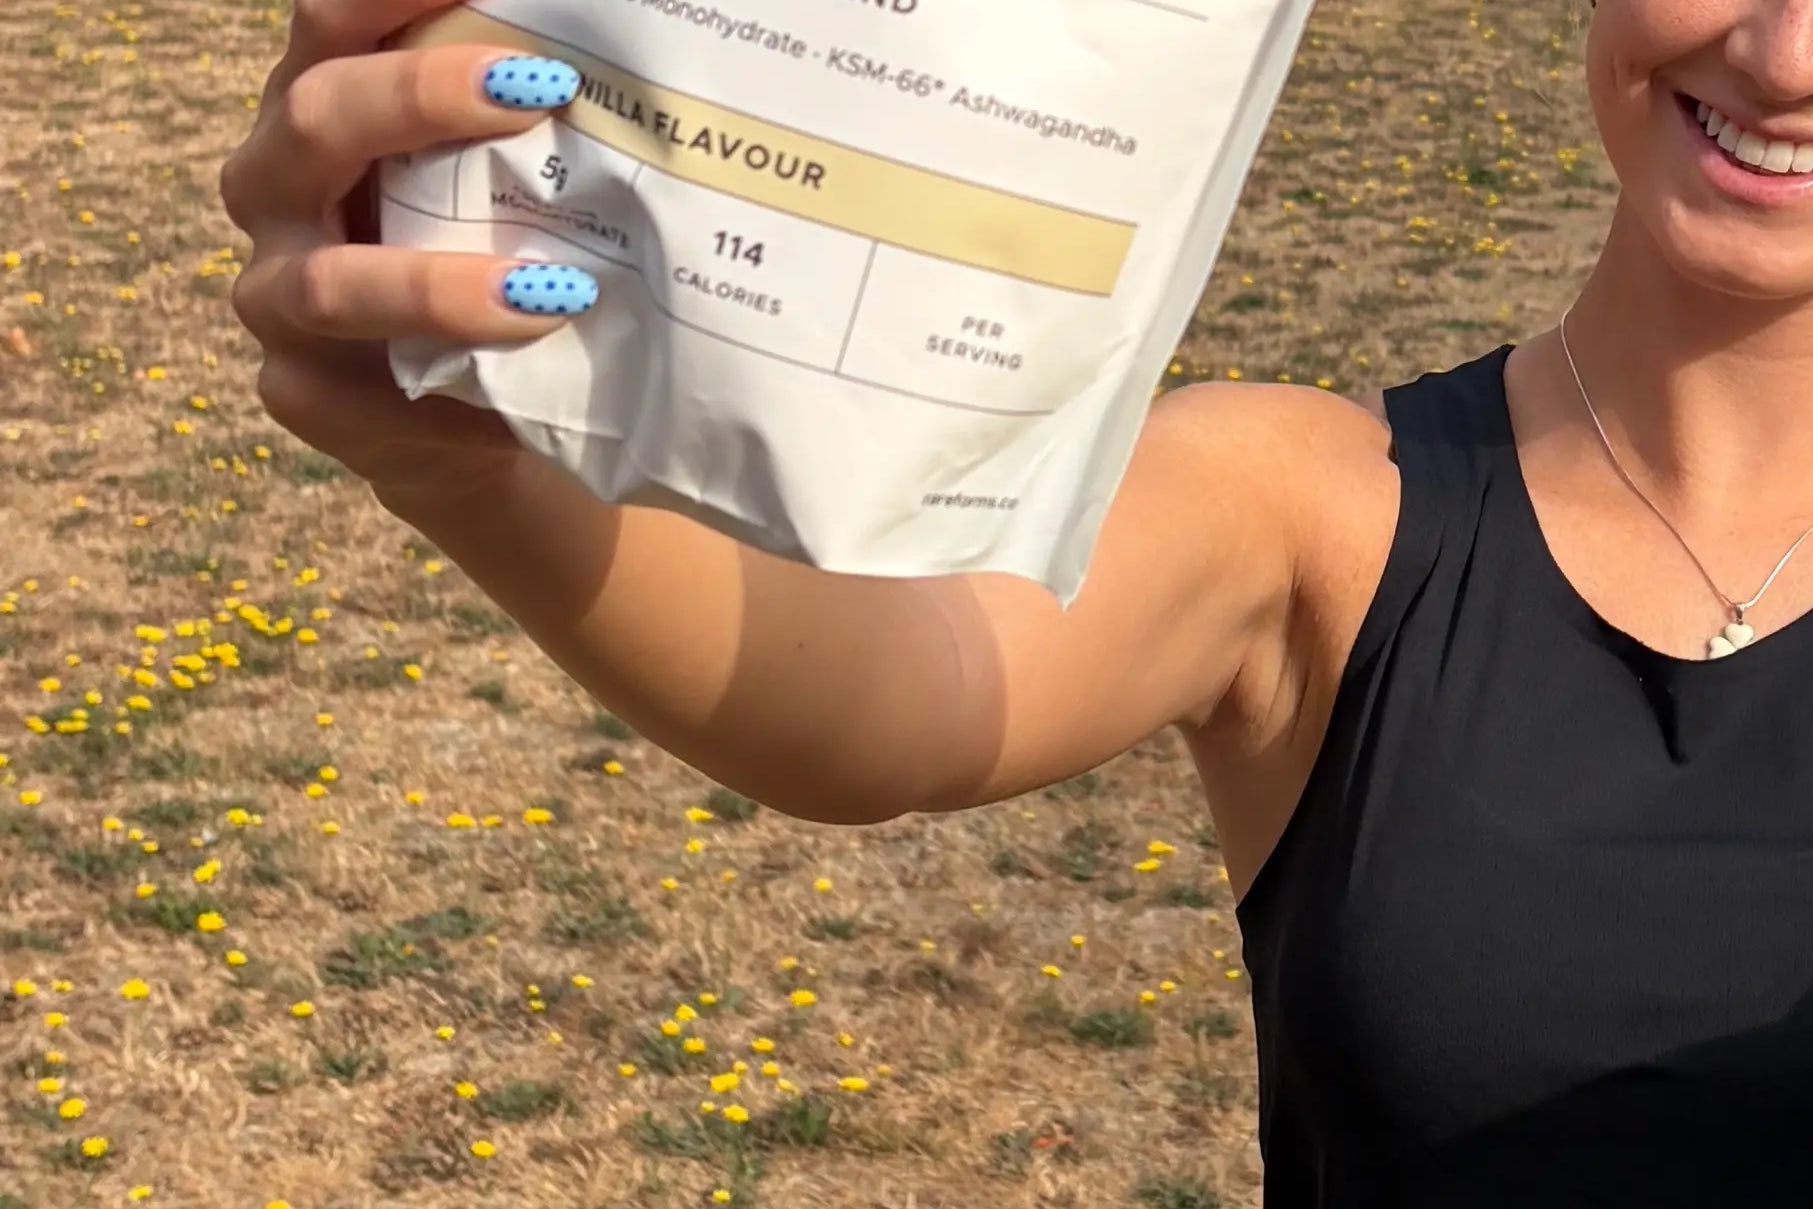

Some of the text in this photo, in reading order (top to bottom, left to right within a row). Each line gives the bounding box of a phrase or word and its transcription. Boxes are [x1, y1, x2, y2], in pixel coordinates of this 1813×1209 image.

[579, 73, 826, 190] NILLA FLAVOUR
[951, 86, 1138, 157] Ashwagandha
[714, 230, 765, 267] 114
[672, 266, 783, 316] CALORIES
[960, 314, 1005, 340] PER
[925, 333, 1024, 371] SERVING
